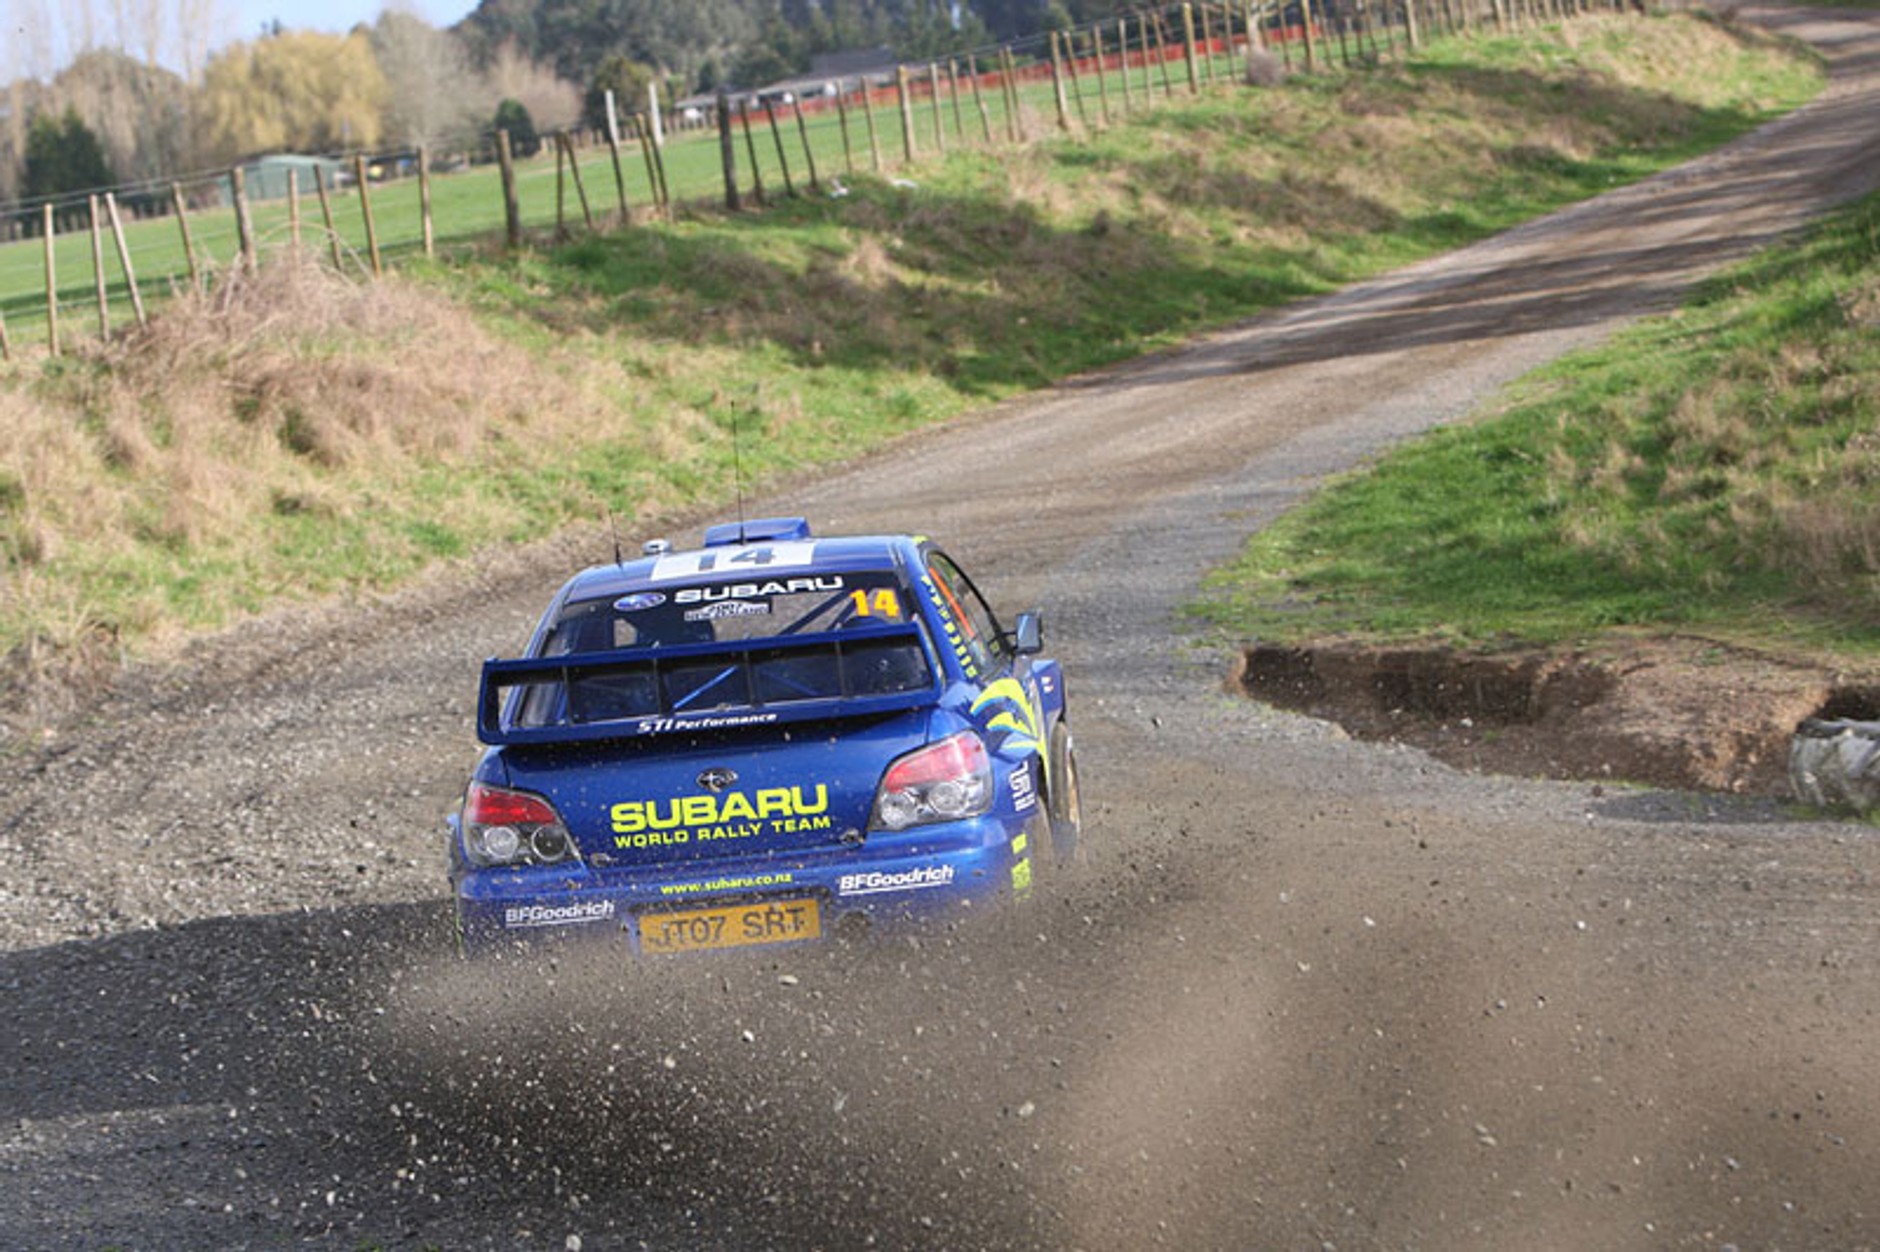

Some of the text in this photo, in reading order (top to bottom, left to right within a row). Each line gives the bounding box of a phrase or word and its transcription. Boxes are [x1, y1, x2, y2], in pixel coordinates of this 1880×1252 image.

[698, 547, 776, 572] 14
[674, 576, 844, 603] SUBARU
[850, 588, 900, 617] 14
[637, 713, 777, 734] STI Performance
[610, 784, 829, 833] SUBARU
[614, 816, 831, 848] WORLD RALLY TEAM
[660, 873, 793, 895] www.subaru.co.nz
[840, 855, 954, 890] BFGoodrich
[505, 900, 615, 927] BFGoodrich
[742, 907, 806, 938] SRT
